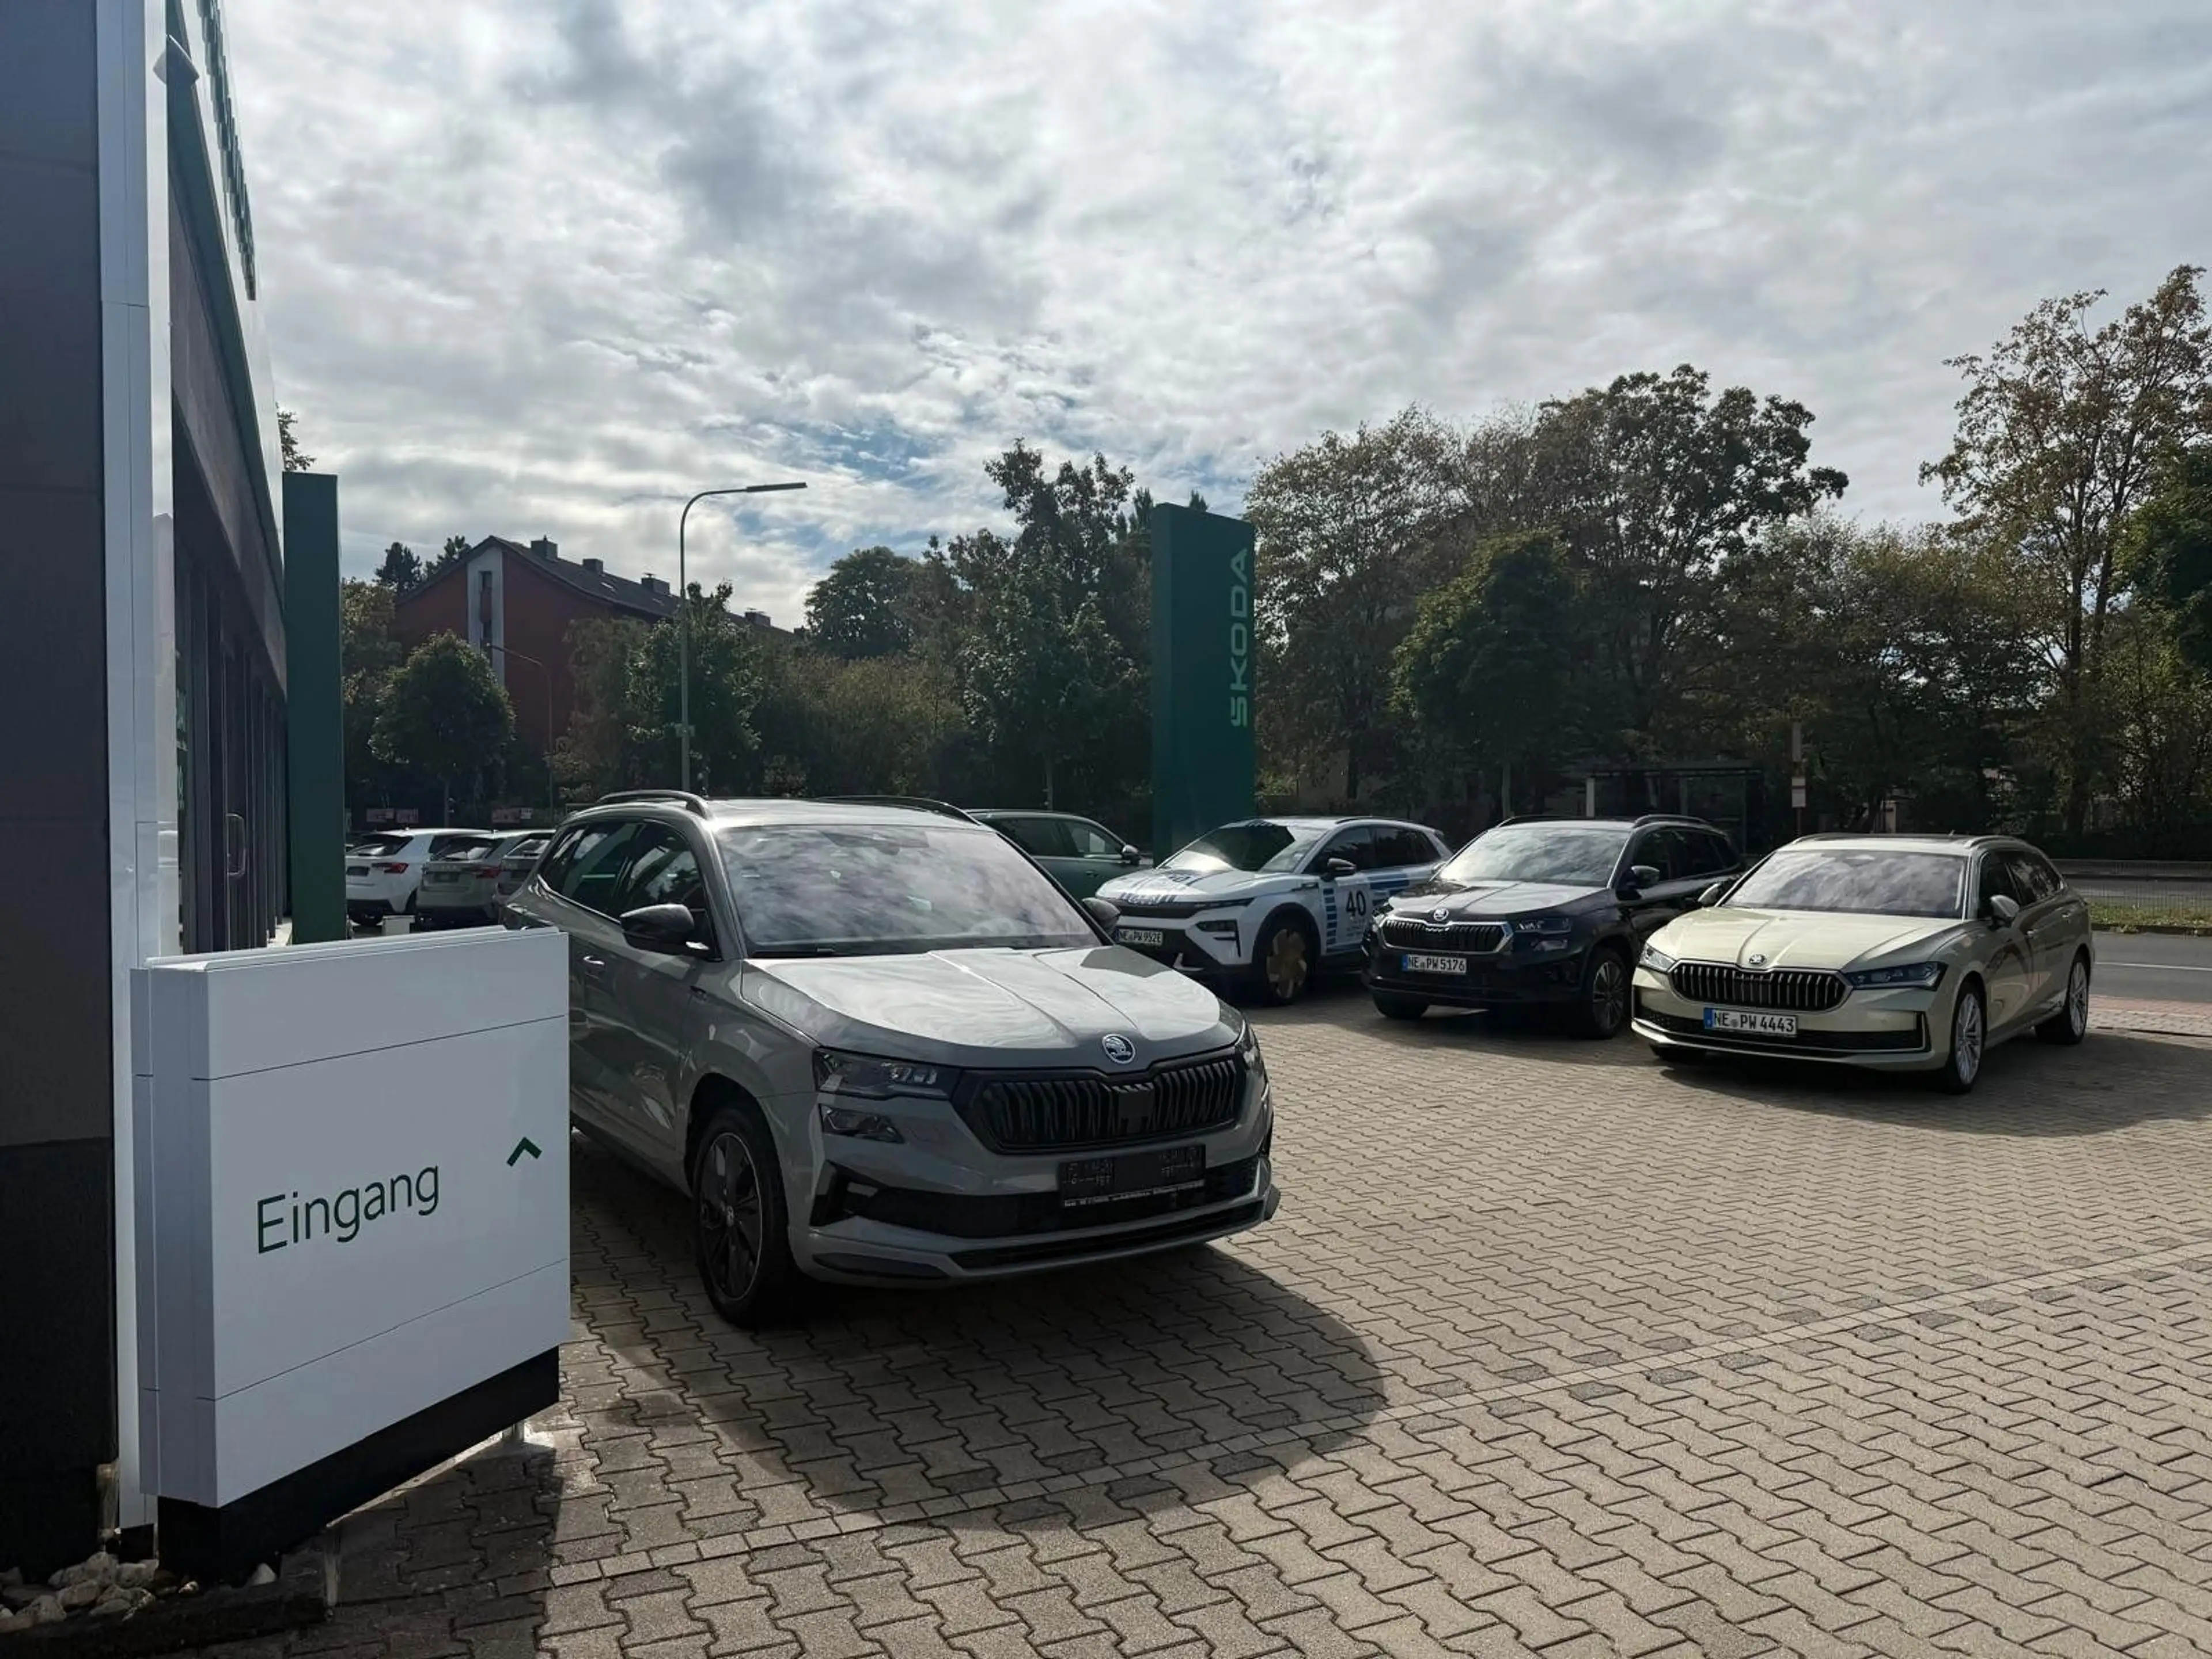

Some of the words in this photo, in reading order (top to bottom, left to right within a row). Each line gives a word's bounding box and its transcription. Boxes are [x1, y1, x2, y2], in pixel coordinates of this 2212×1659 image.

[1346, 890, 1366, 916] 40
[1408, 956, 1419, 968] NE
[1426, 958, 1438, 969] PW
[1440, 959, 1465, 971] 5176
[1714, 1012, 1730, 1027] NE
[1740, 1014, 1756, 1029] PW
[1760, 1016, 1794, 1032] 4443
[257, 1165, 438, 1254] Eingang
